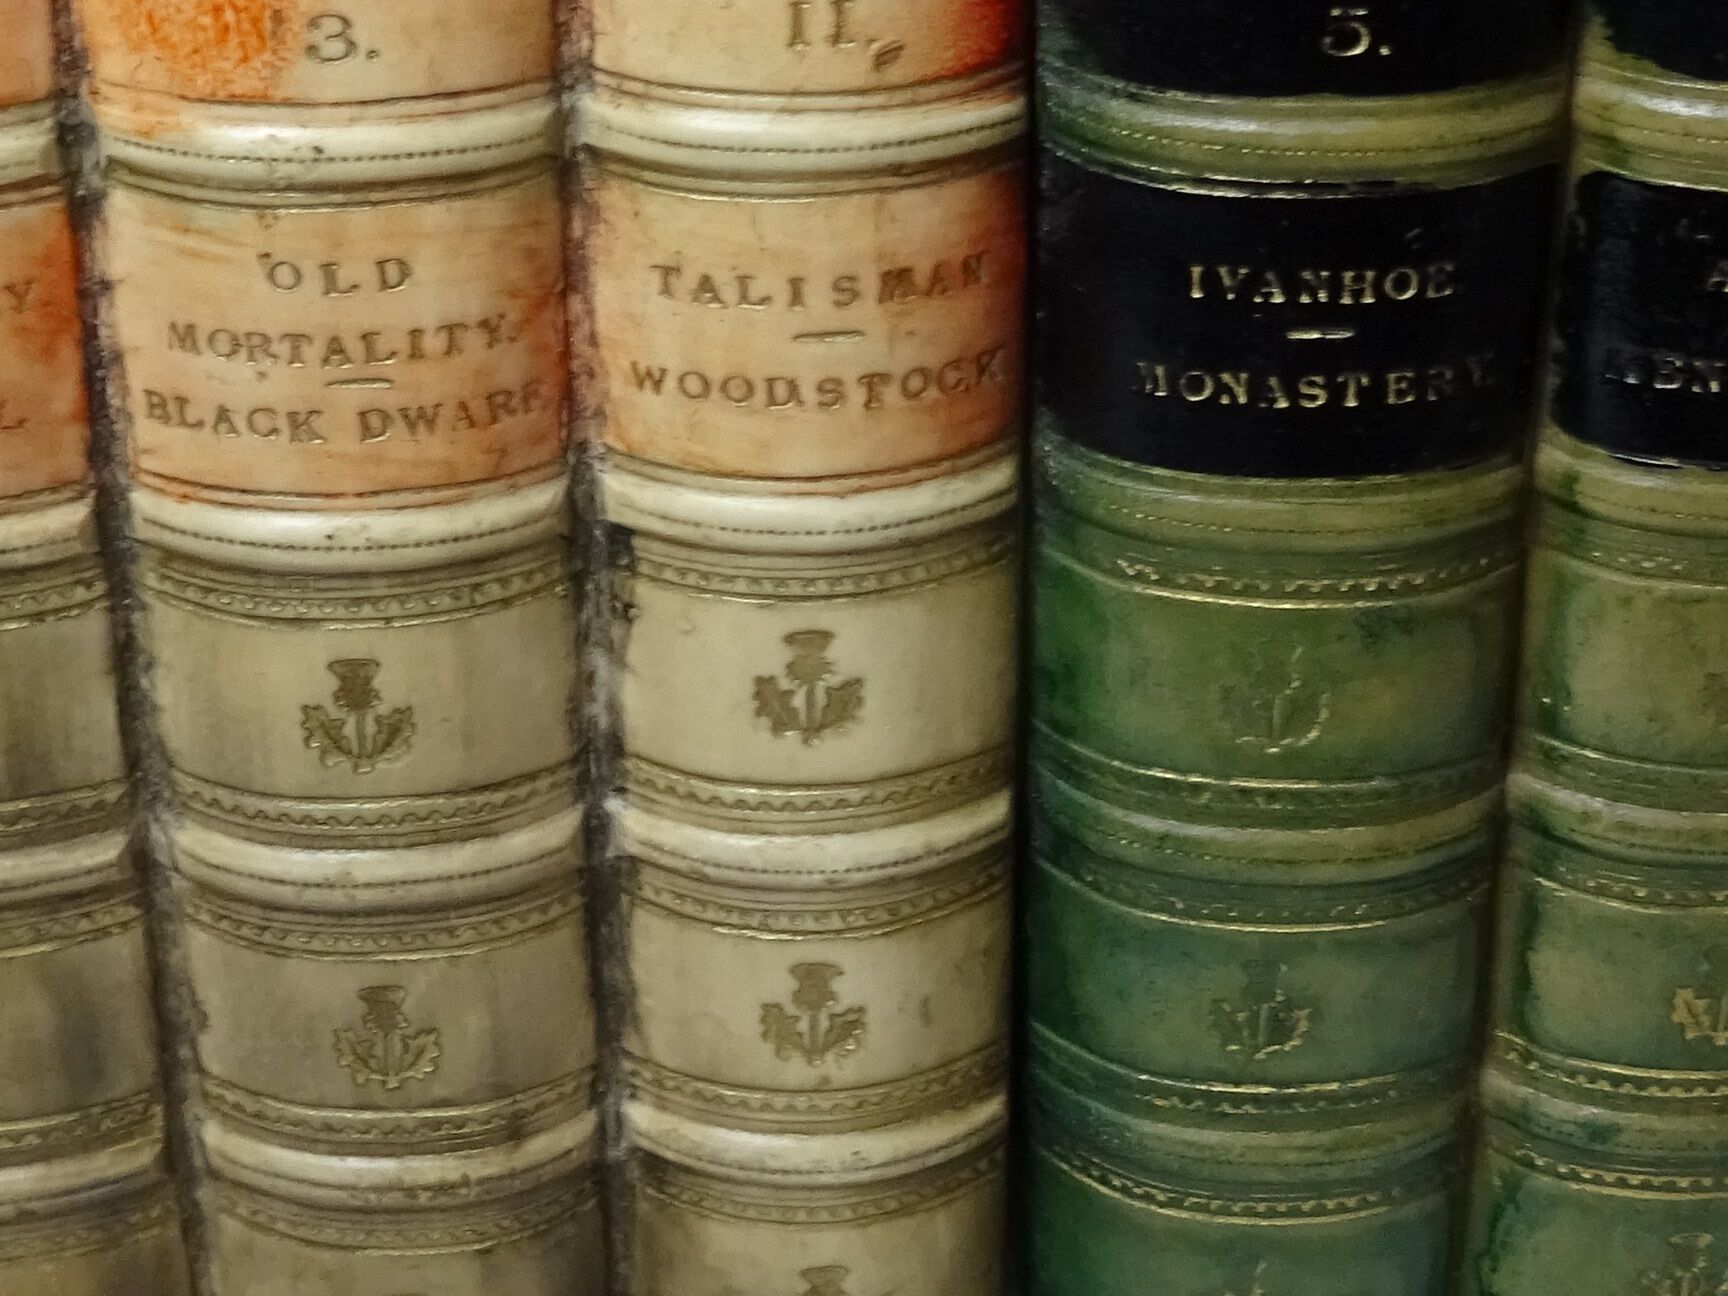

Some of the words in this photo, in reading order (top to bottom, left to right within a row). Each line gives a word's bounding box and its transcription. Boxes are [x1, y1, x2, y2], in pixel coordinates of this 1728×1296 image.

[304, 12, 380, 64] 3.
[1322, 8, 1392, 56] 5.
[267, 256, 413, 298] OLD
[650, 249, 991, 311] TALISMAN
[1188, 262, 1459, 304] IVANHOE
[629, 345, 1005, 411] WOODSTOCK
[142, 388, 327, 446] BLACK
[355, 379, 543, 445] DWARF
